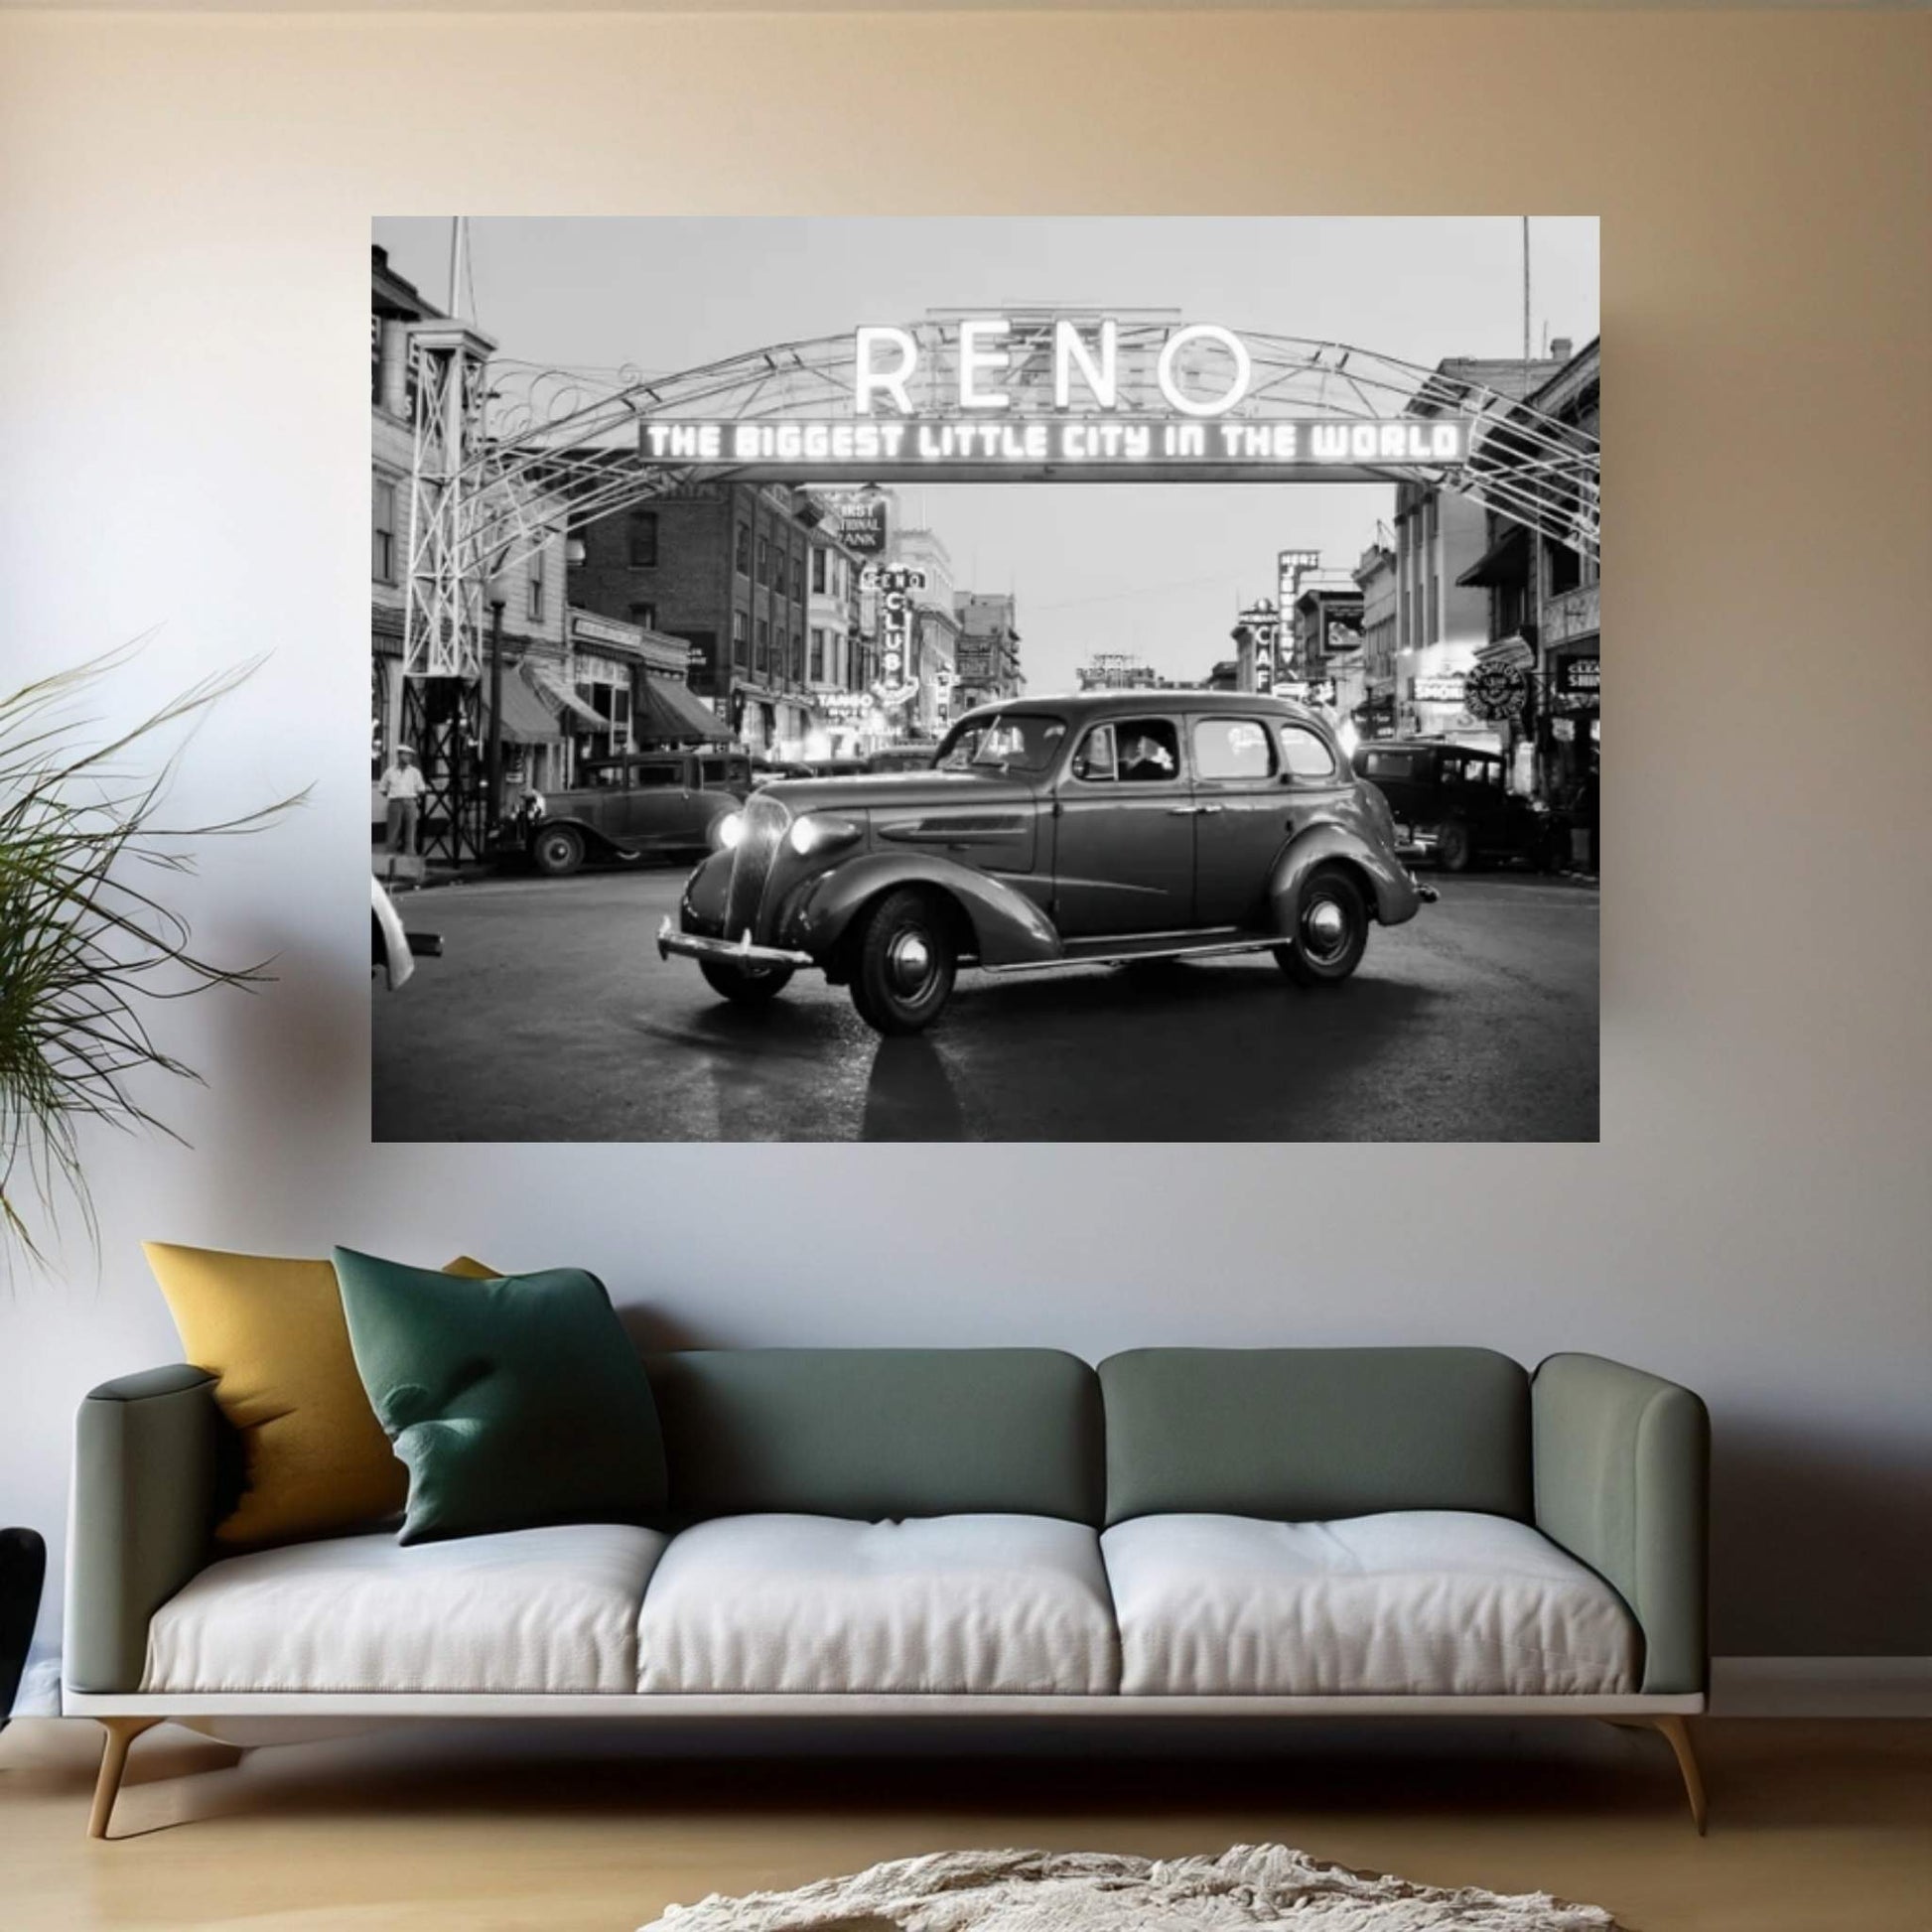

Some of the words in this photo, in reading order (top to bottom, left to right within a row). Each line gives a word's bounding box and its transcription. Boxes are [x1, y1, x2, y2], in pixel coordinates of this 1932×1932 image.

[853, 319, 1253, 418] RENO
[647, 425, 720, 457] THE
[736, 425, 904, 457] BIGGEST
[918, 425, 1047, 457] LITTLE
[1062, 425, 1150, 457] CITY
[1220, 425, 1297, 457] THE
[1311, 425, 1458, 457] WORLD
[885, 592, 905, 672] CLUB
